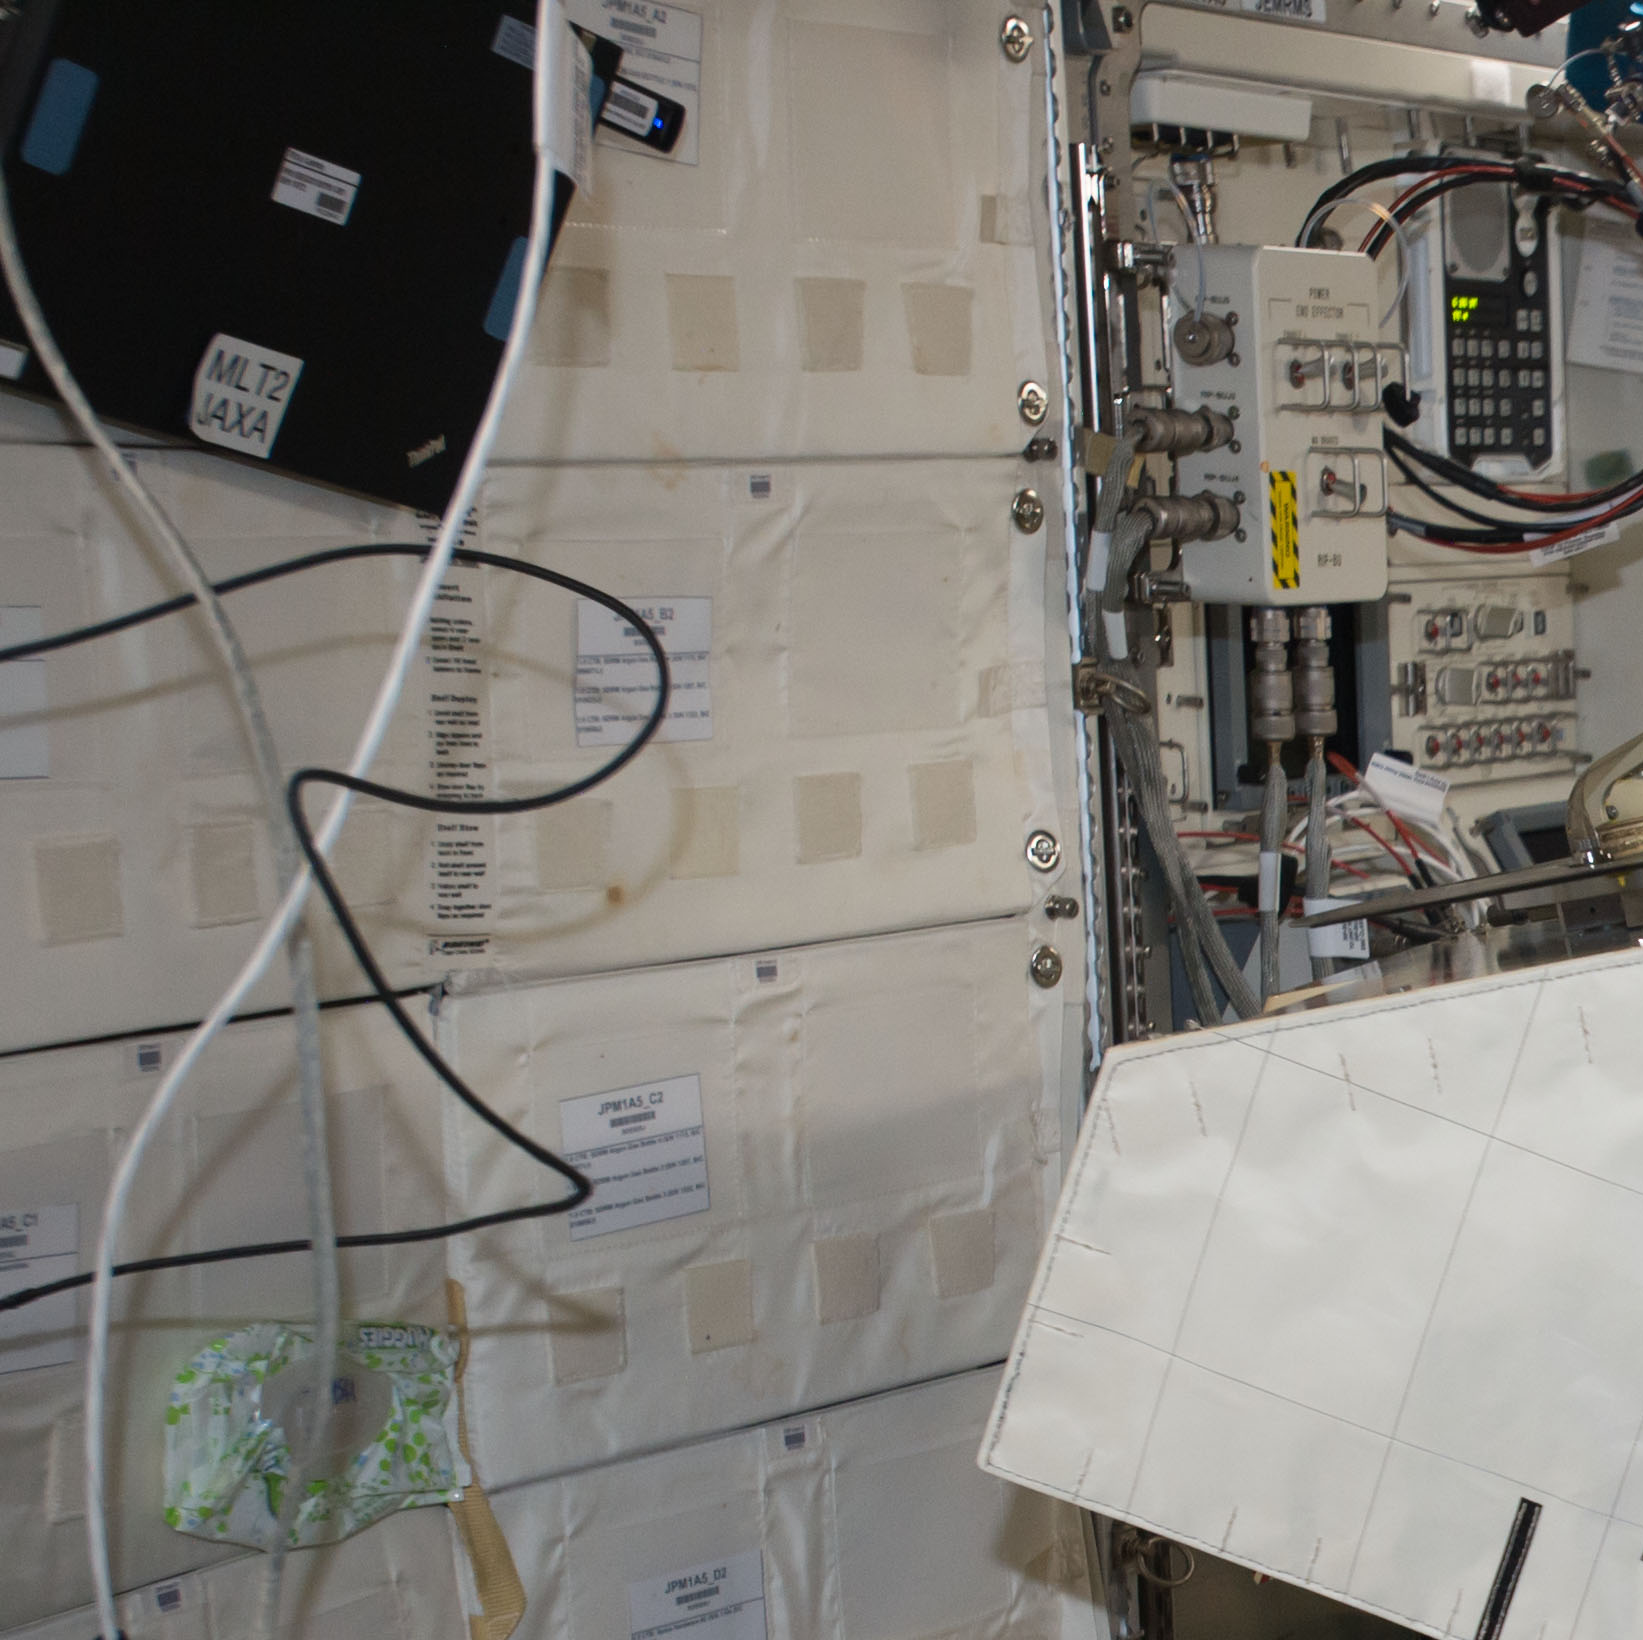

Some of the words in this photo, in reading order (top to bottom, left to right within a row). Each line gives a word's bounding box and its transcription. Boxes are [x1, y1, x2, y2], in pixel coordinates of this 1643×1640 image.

[207, 348, 290, 402] MLT2
[197, 392, 270, 444] JAXA
[598, 1092, 663, 1115] JPM1A5_C2
[665, 1567, 727, 1594] JPM1A5_D2
